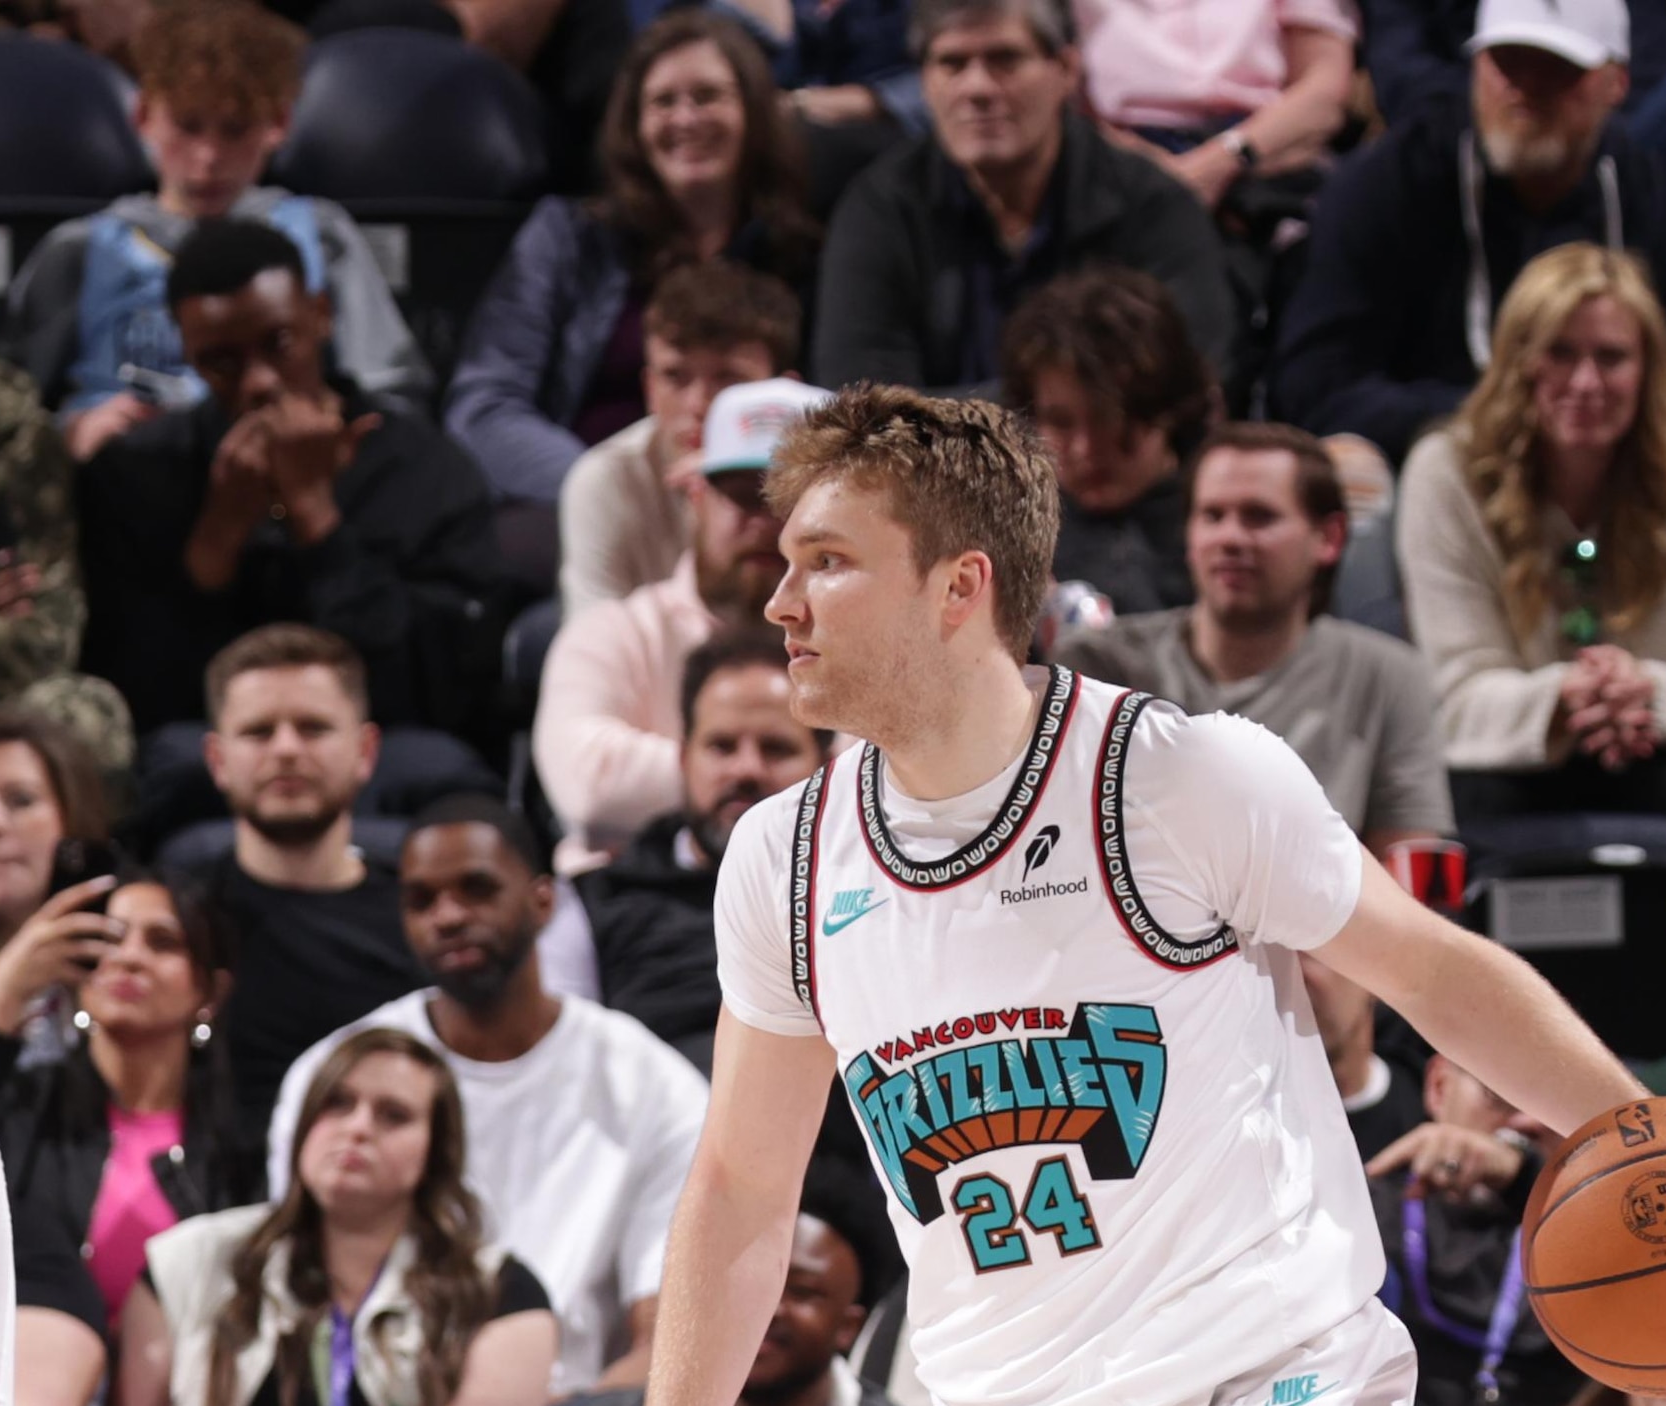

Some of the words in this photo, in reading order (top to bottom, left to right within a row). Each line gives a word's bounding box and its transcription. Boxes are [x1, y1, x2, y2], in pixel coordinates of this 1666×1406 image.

[829, 886, 876, 917] NIKE
[1000, 877, 1089, 905] Robinhood
[875, 1005, 1069, 1065] VANCOUVER
[844, 1000, 1168, 1227] GRIZZLIES
[949, 1152, 1104, 1276] 24
[1271, 1371, 1319, 1405] NIKE
